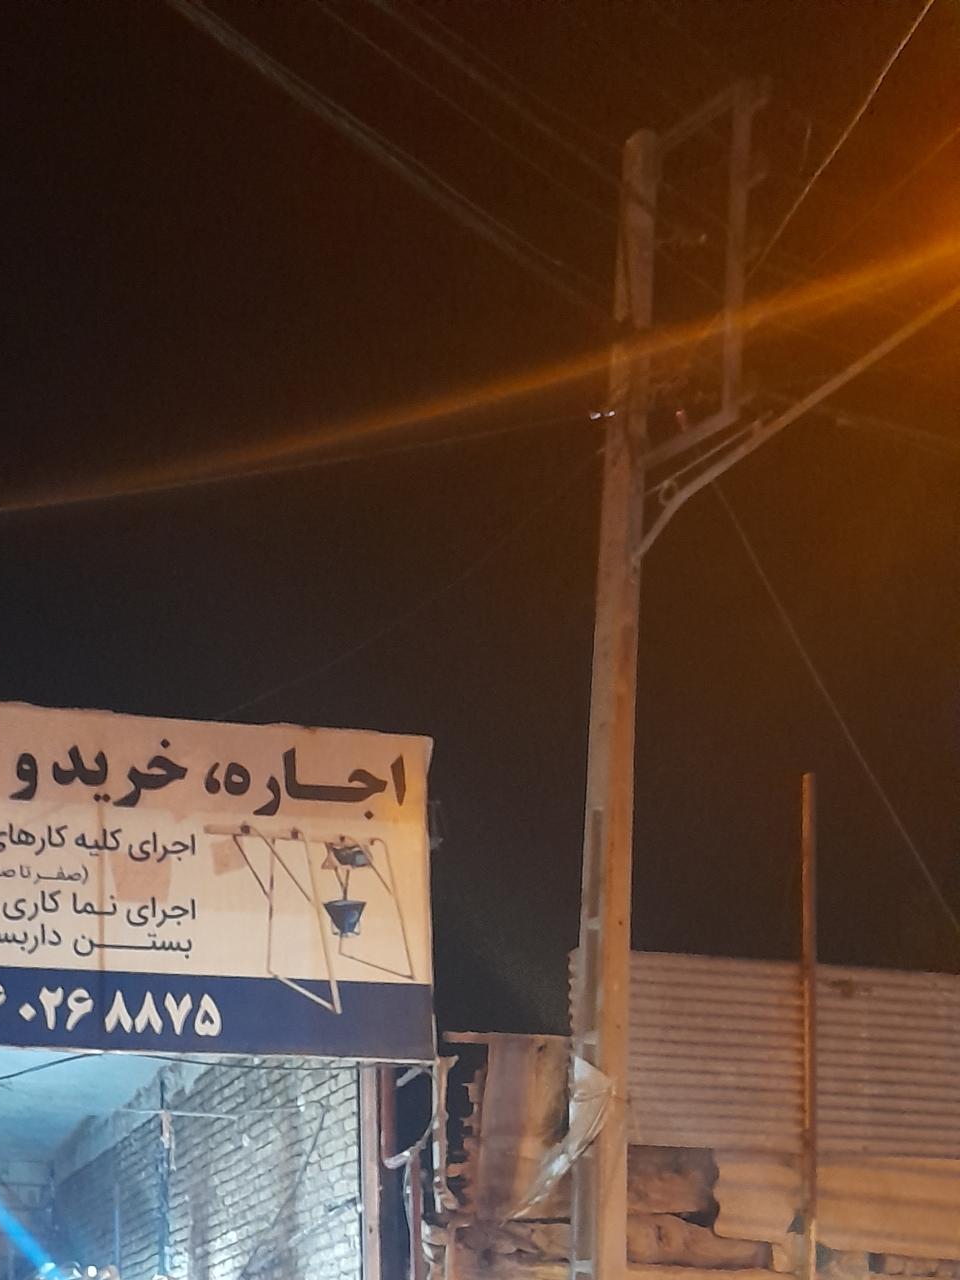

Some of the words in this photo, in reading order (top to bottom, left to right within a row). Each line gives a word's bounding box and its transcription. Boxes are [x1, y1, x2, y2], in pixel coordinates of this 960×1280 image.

[8, 752, 40, 801] و
[52, 738, 189, 808] خرید
[74, 828, 122, 857] کلیه
[127, 831, 196, 864] اجرای
[2, 889, 61, 921] کاری
[72, 891, 118, 917] نما
[126, 896, 196, 928] اجرای
[73, 931, 193, 960] بستن
